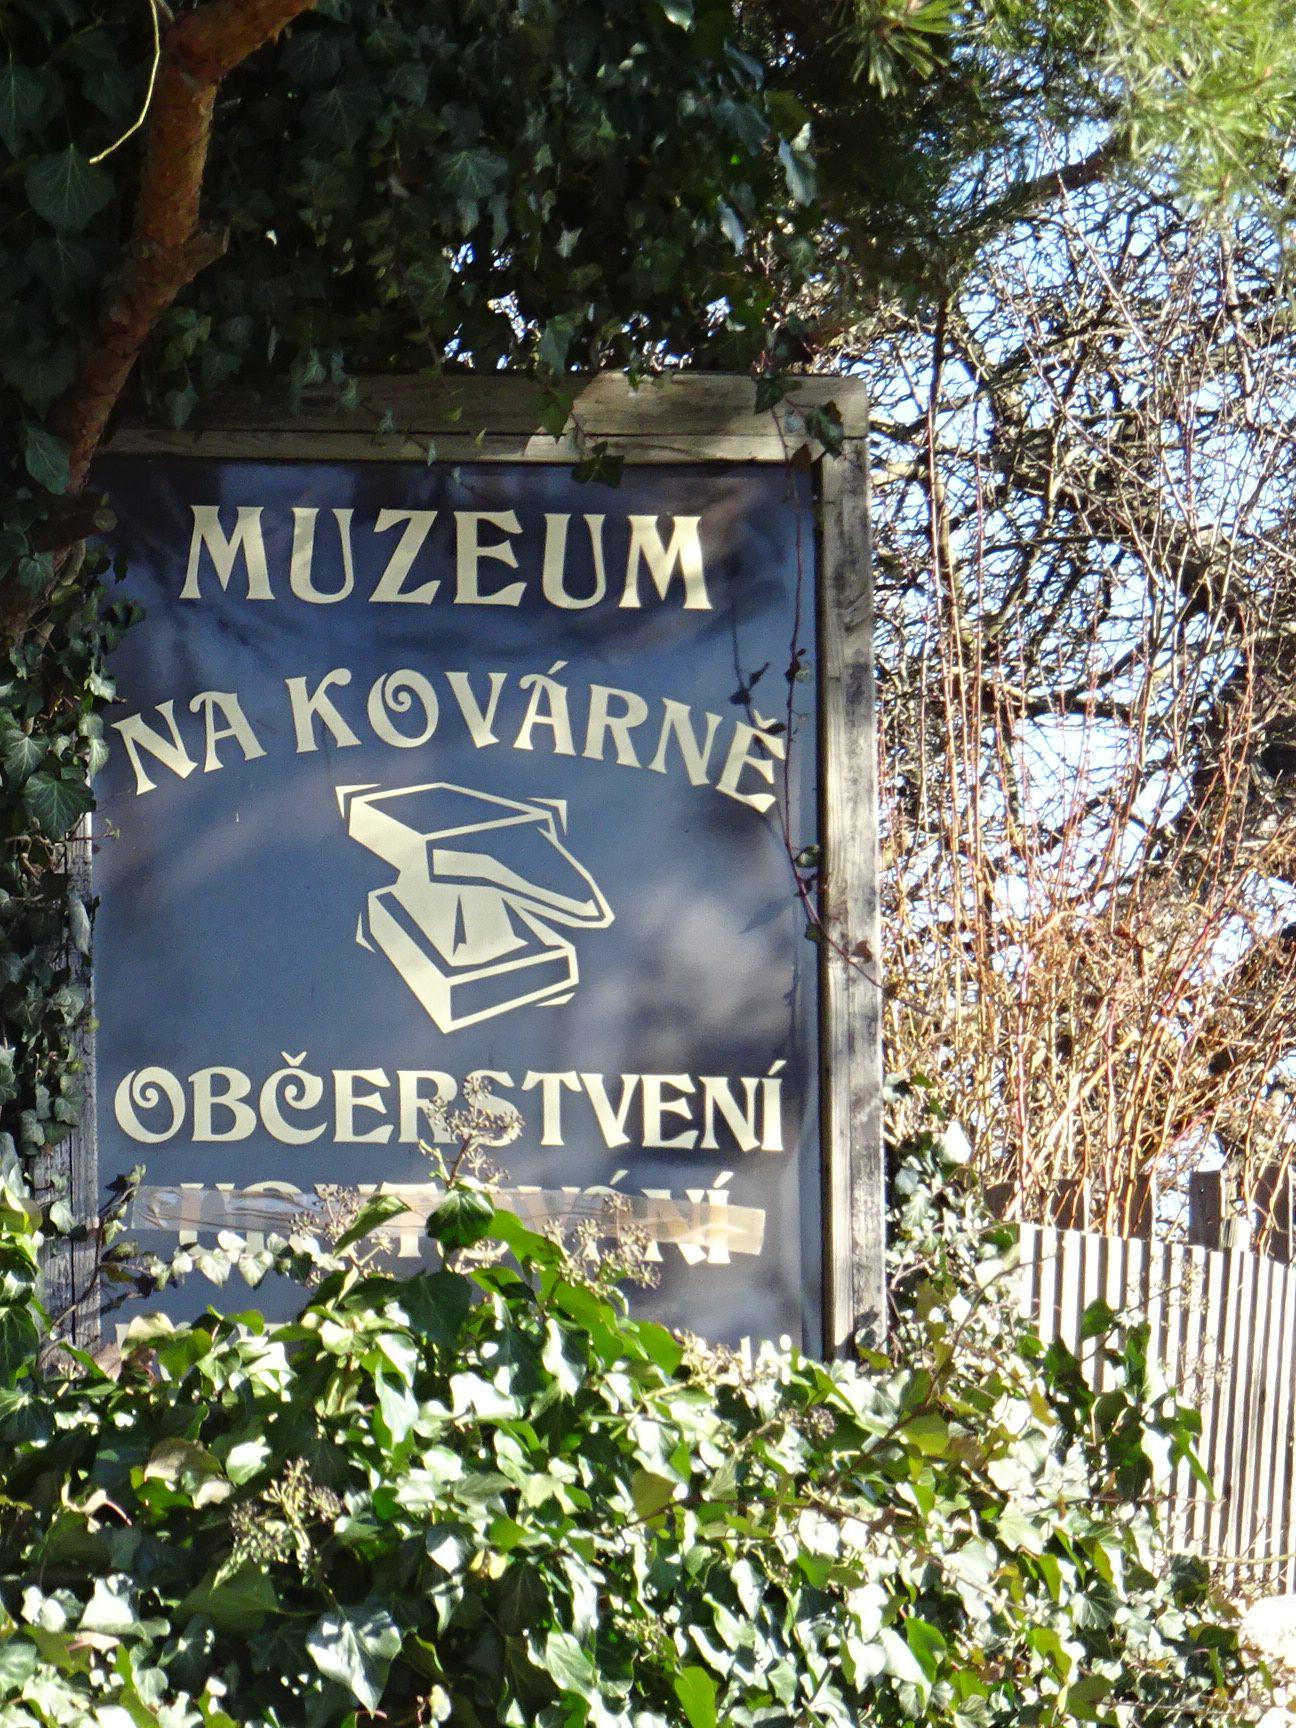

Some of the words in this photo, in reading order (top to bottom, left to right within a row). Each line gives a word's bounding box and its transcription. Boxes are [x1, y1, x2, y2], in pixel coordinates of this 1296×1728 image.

[179, 505, 713, 610] MUZEUM
[111, 690, 269, 796] NA
[284, 660, 787, 814] KOVÁRNĚ
[113, 1050, 787, 1153] OBČERSTVENÍ
